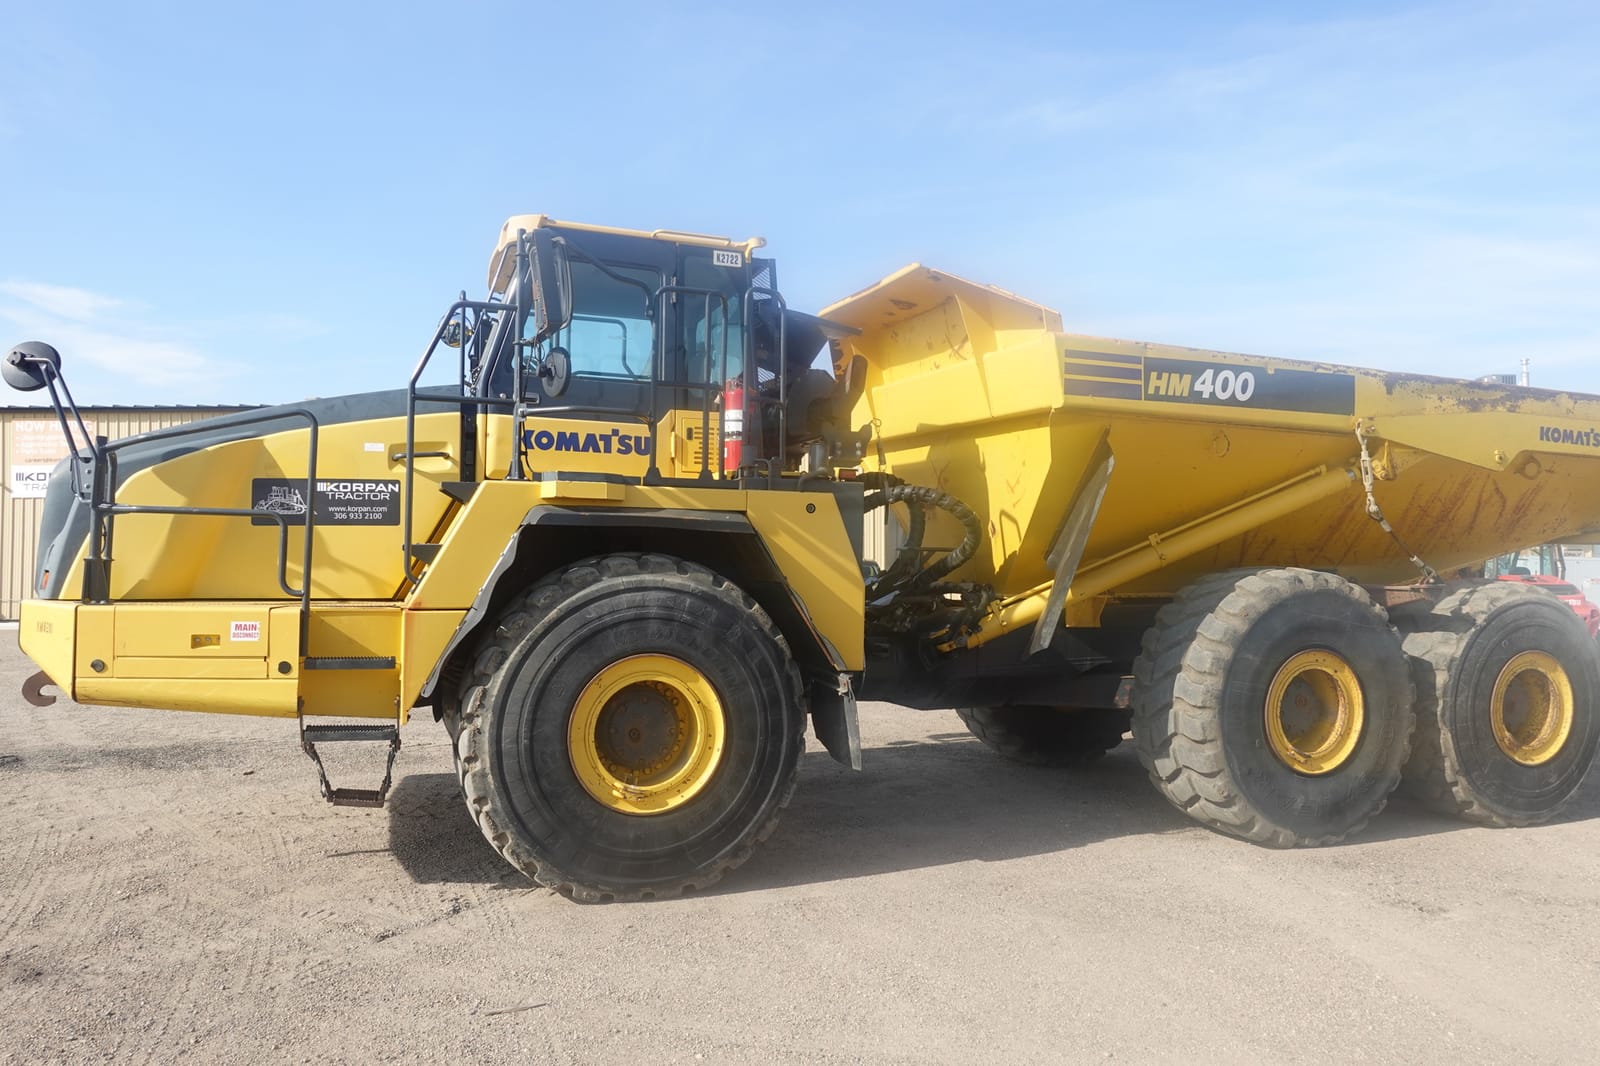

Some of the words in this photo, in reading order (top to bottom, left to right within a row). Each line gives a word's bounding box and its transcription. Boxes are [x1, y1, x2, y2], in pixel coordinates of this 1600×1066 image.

[716, 252, 739, 265] K2722
[15, 421, 45, 432] NOW
[326, 482, 399, 492] KORPAN
[325, 492, 390, 500] TRACTOR
[328, 505, 388, 513] www.korpan.com
[234, 623, 257, 631] MAIN
